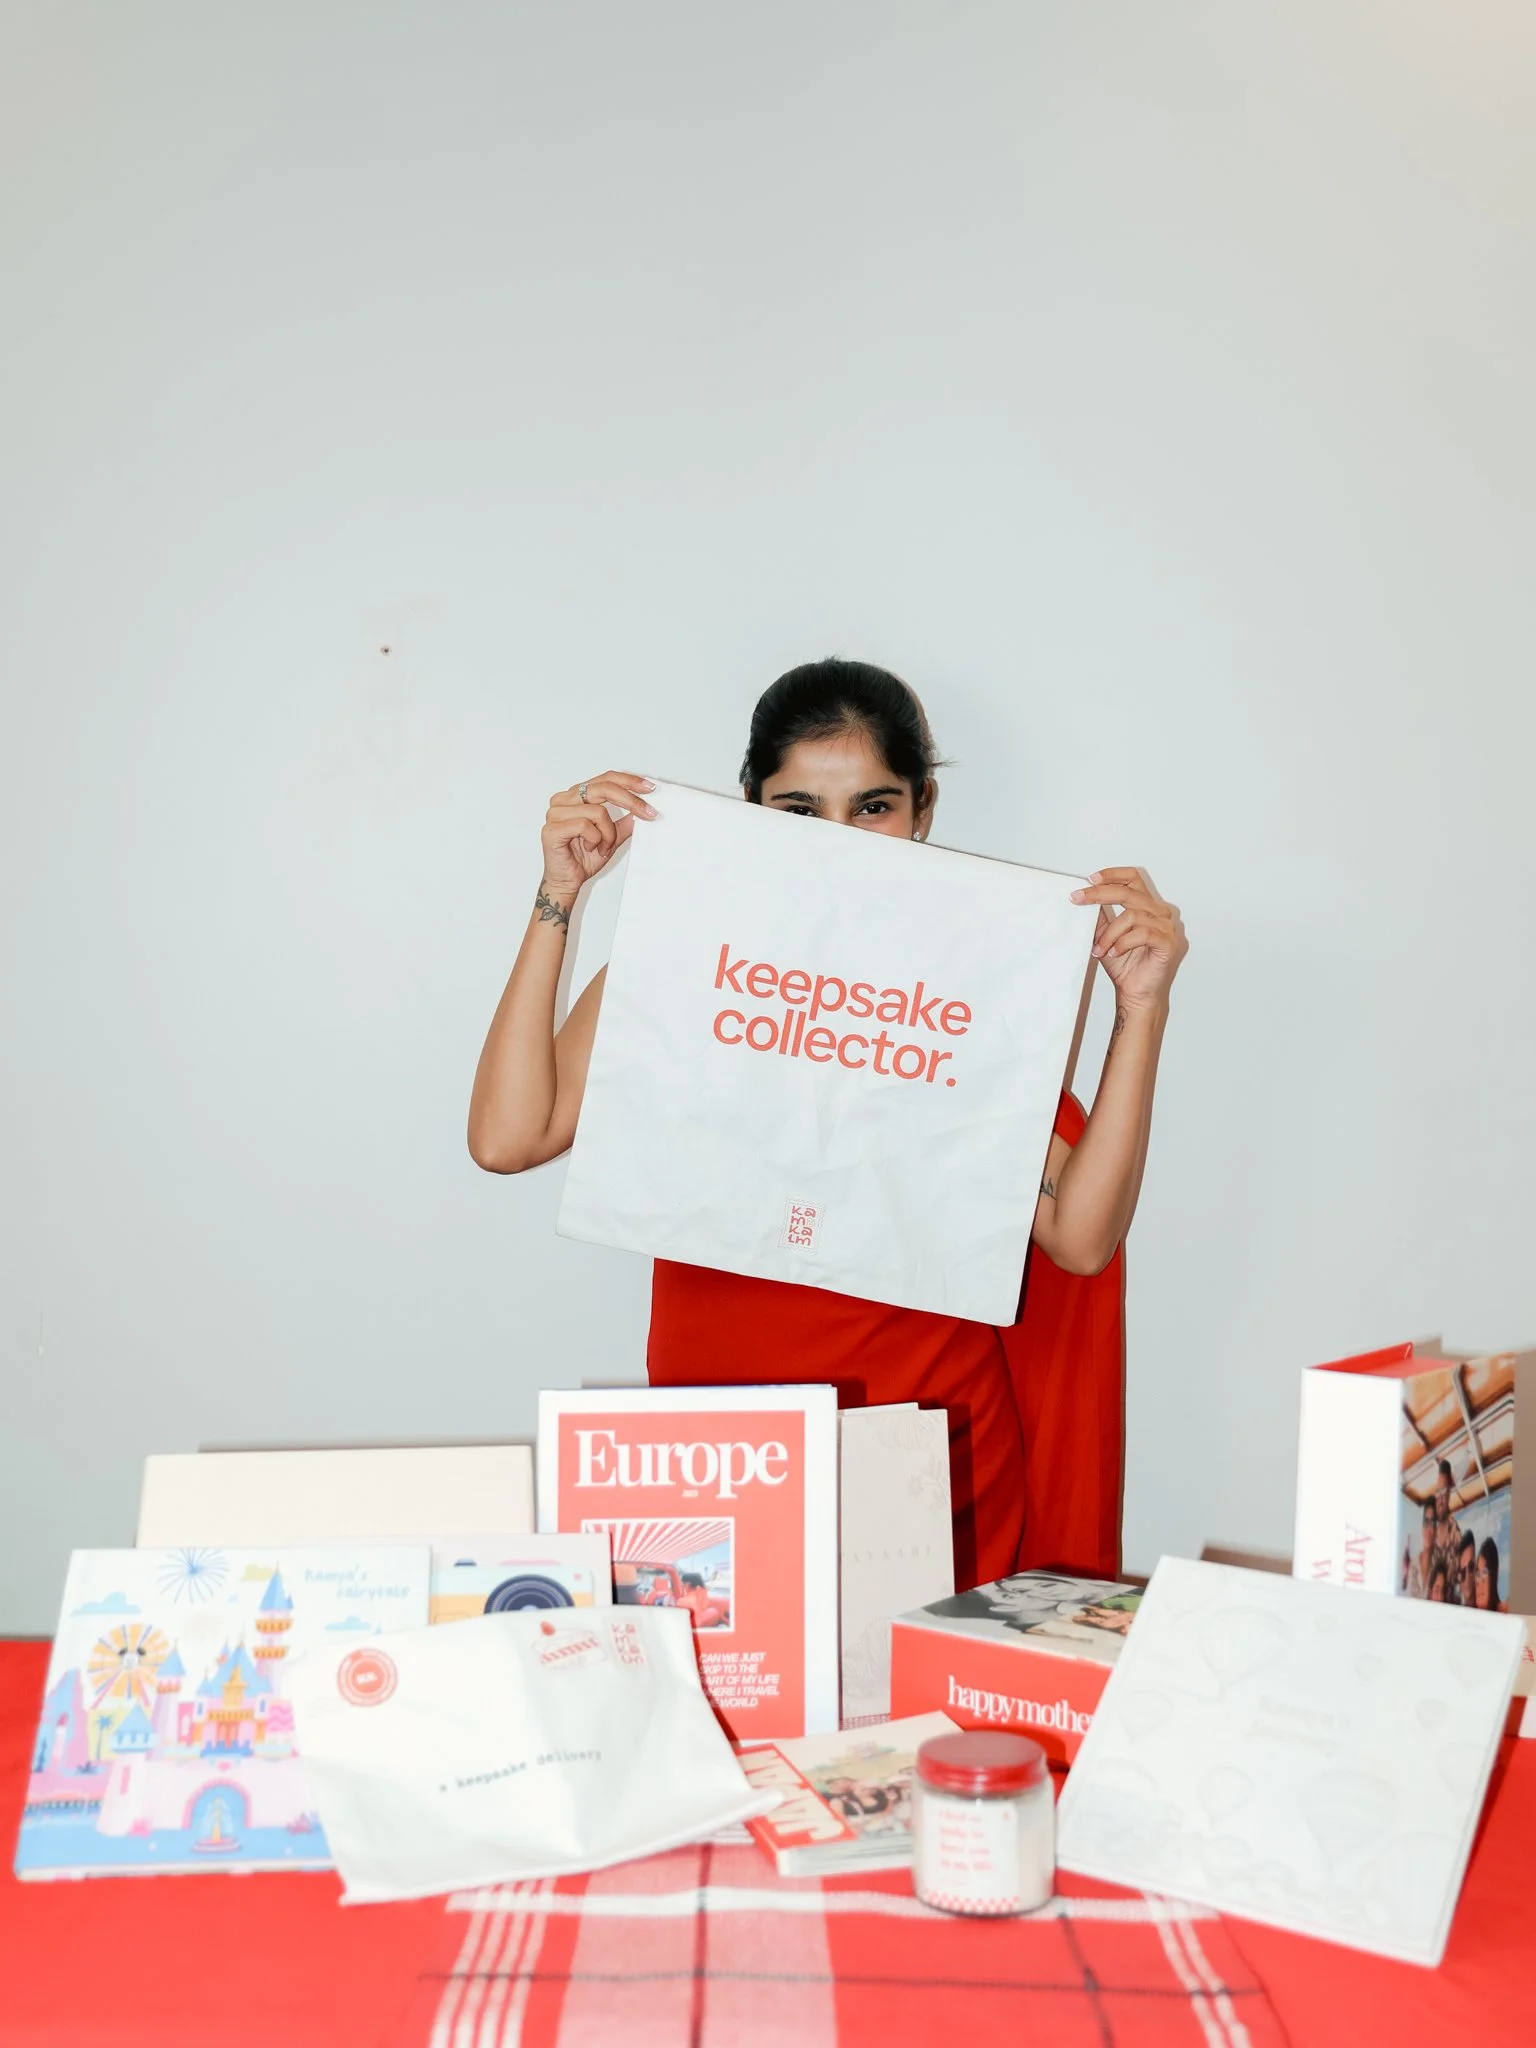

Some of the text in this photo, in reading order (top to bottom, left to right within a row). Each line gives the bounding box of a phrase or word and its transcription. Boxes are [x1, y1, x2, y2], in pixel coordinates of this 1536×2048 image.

[714, 943, 972, 1036] keepsake
[713, 1008, 957, 1088] collector.
[573, 1429, 789, 1499] Europe
[721, 1652, 739, 1664] WE
[740, 1651, 767, 1663] JUST
[723, 1663, 738, 1674] TO
[738, 1663, 758, 1674] THE
[726, 1674, 740, 1685] OF
[740, 1674, 758, 1685] MY
[758, 1674, 781, 1685] LIFE
[743, 1685, 780, 1696] TRAVEL
[719, 1697, 758, 1708] WORLD
[947, 1673, 1016, 1723] happy
[455, 1761, 527, 1789] keepsake
[536, 1749, 602, 1766] delivery
